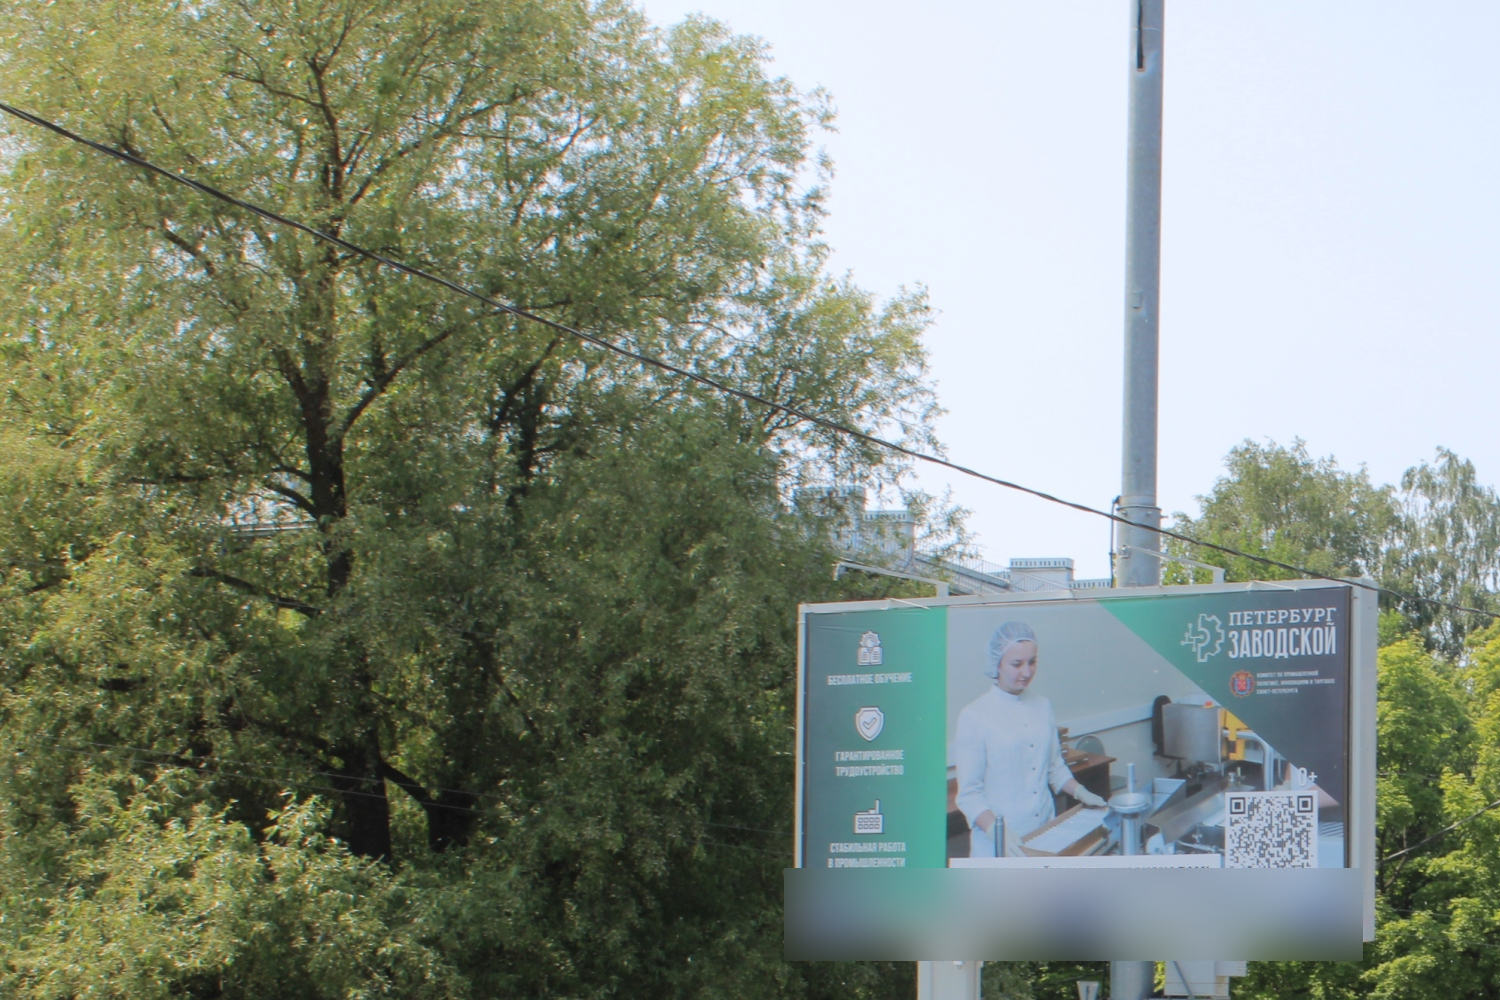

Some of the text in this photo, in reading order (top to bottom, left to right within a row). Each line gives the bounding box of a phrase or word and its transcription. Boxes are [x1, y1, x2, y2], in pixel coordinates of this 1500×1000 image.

[1229, 607, 1336, 626] ПЕТЕРБУРГ
[1229, 622, 1336, 659] ЗАВОДСКОЙ
[827, 672, 912, 685] БЕСПЛАТНОЕ ОБУЧЕНИЕ
[835, 750, 904, 761] ГАРАНТИРОВАННОЕ
[835, 764, 904, 777] ТРУДОУСТРОЙСТВО
[1299, 767, 1318, 786] 0+
[830, 842, 906, 853] СТАБИЛЬНАЯ РАБОТА
